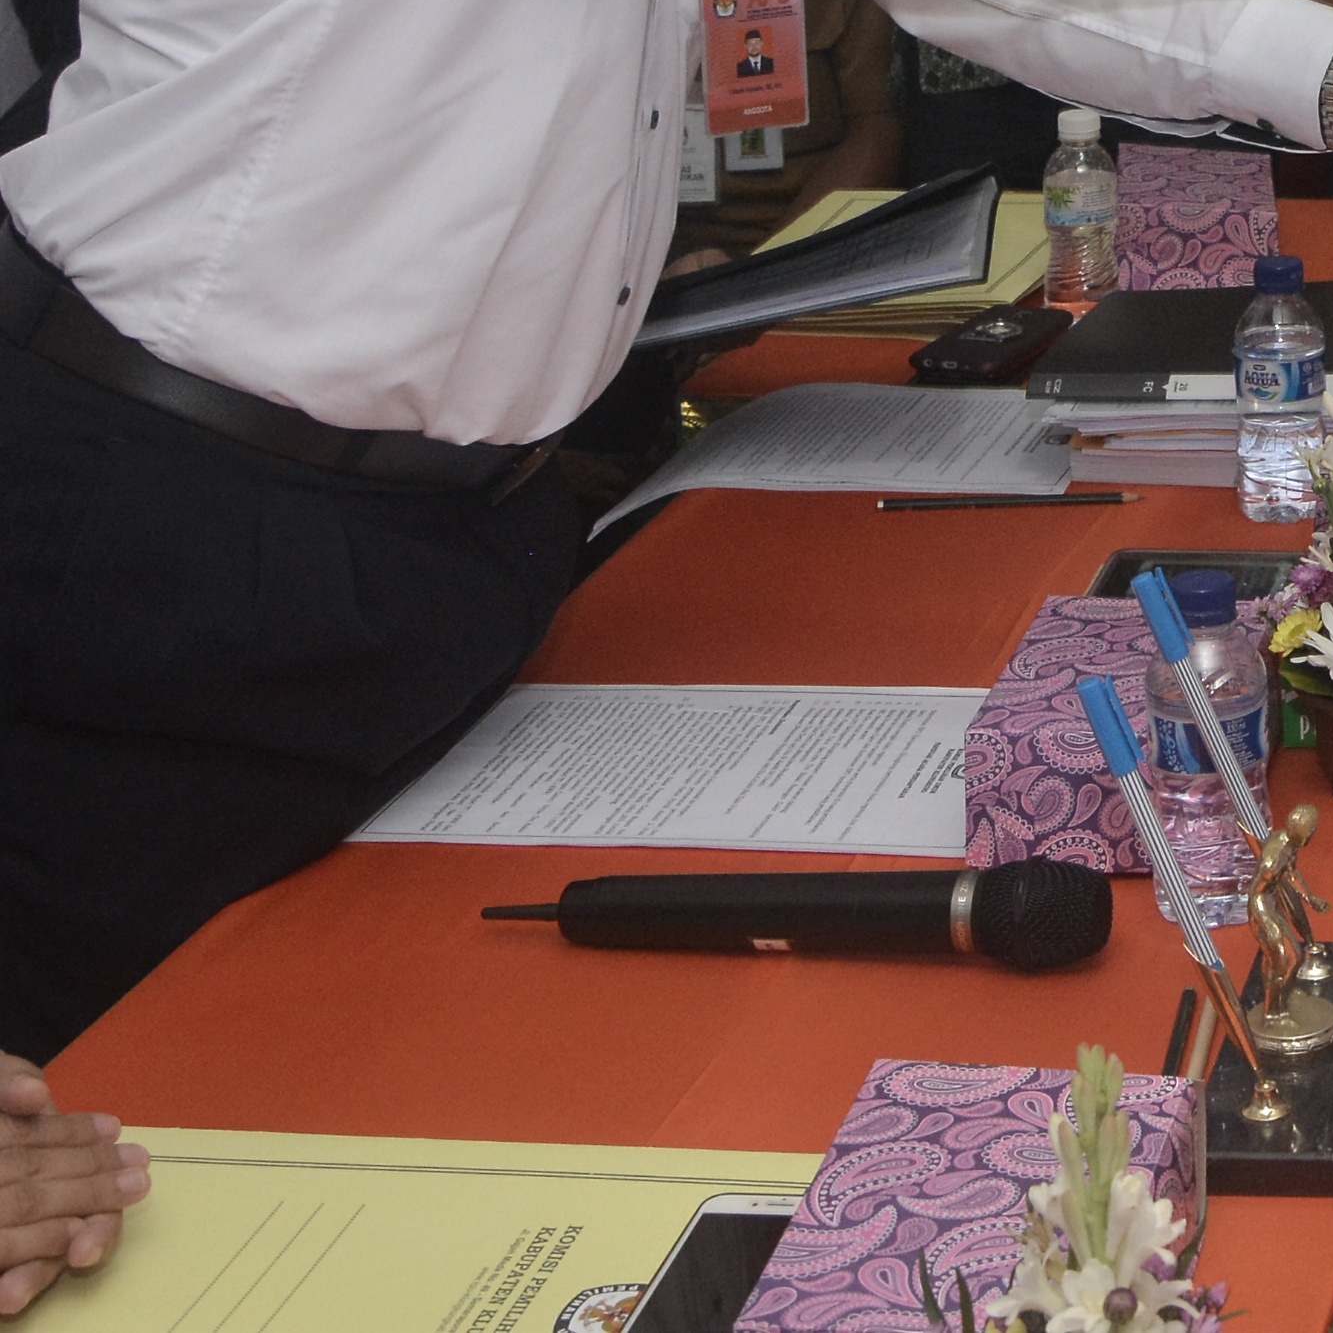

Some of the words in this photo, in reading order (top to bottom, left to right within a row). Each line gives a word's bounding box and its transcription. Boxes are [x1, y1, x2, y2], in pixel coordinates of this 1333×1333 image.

[1244, 369, 1280, 388] AQUA
[489, 1226, 558, 1307] KABUPATEN
[541, 1224, 584, 1274] KOMISI
